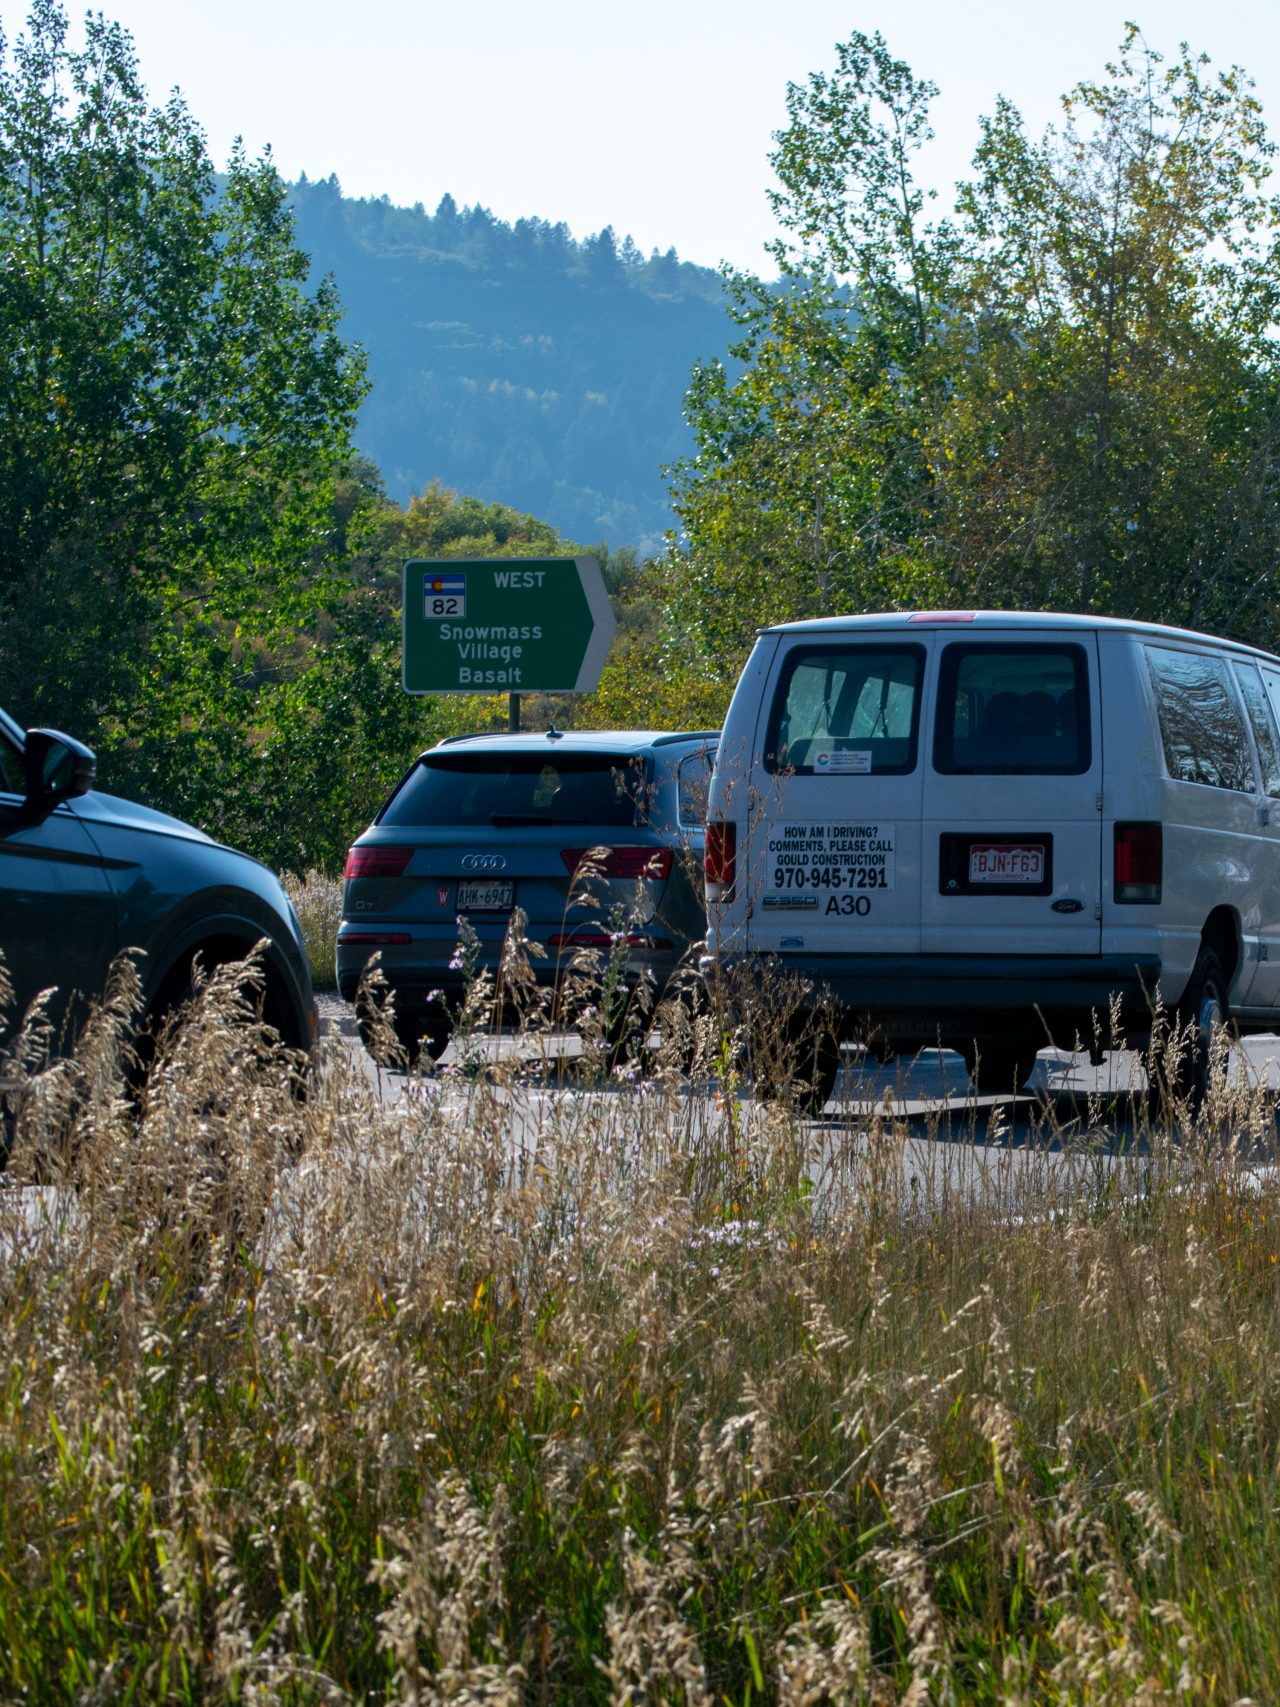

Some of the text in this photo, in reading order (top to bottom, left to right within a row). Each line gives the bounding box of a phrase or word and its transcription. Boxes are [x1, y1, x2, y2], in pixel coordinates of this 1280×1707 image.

[494, 571, 546, 588] WEST
[432, 598, 458, 615] 82
[440, 623, 542, 640] Snowmass
[458, 643, 522, 663] Village
[459, 667, 522, 684] Basalt
[784, 826, 879, 838] HOW AM I DRIVING?
[769, 840, 894, 853] COMMENTS, PLEASE CALL
[777, 854, 886, 866] GOULD CONSTRUCTION
[774, 867, 888, 888] 970-945-7291
[356, 901, 375, 910] Q7
[824, 894, 872, 916] A30
